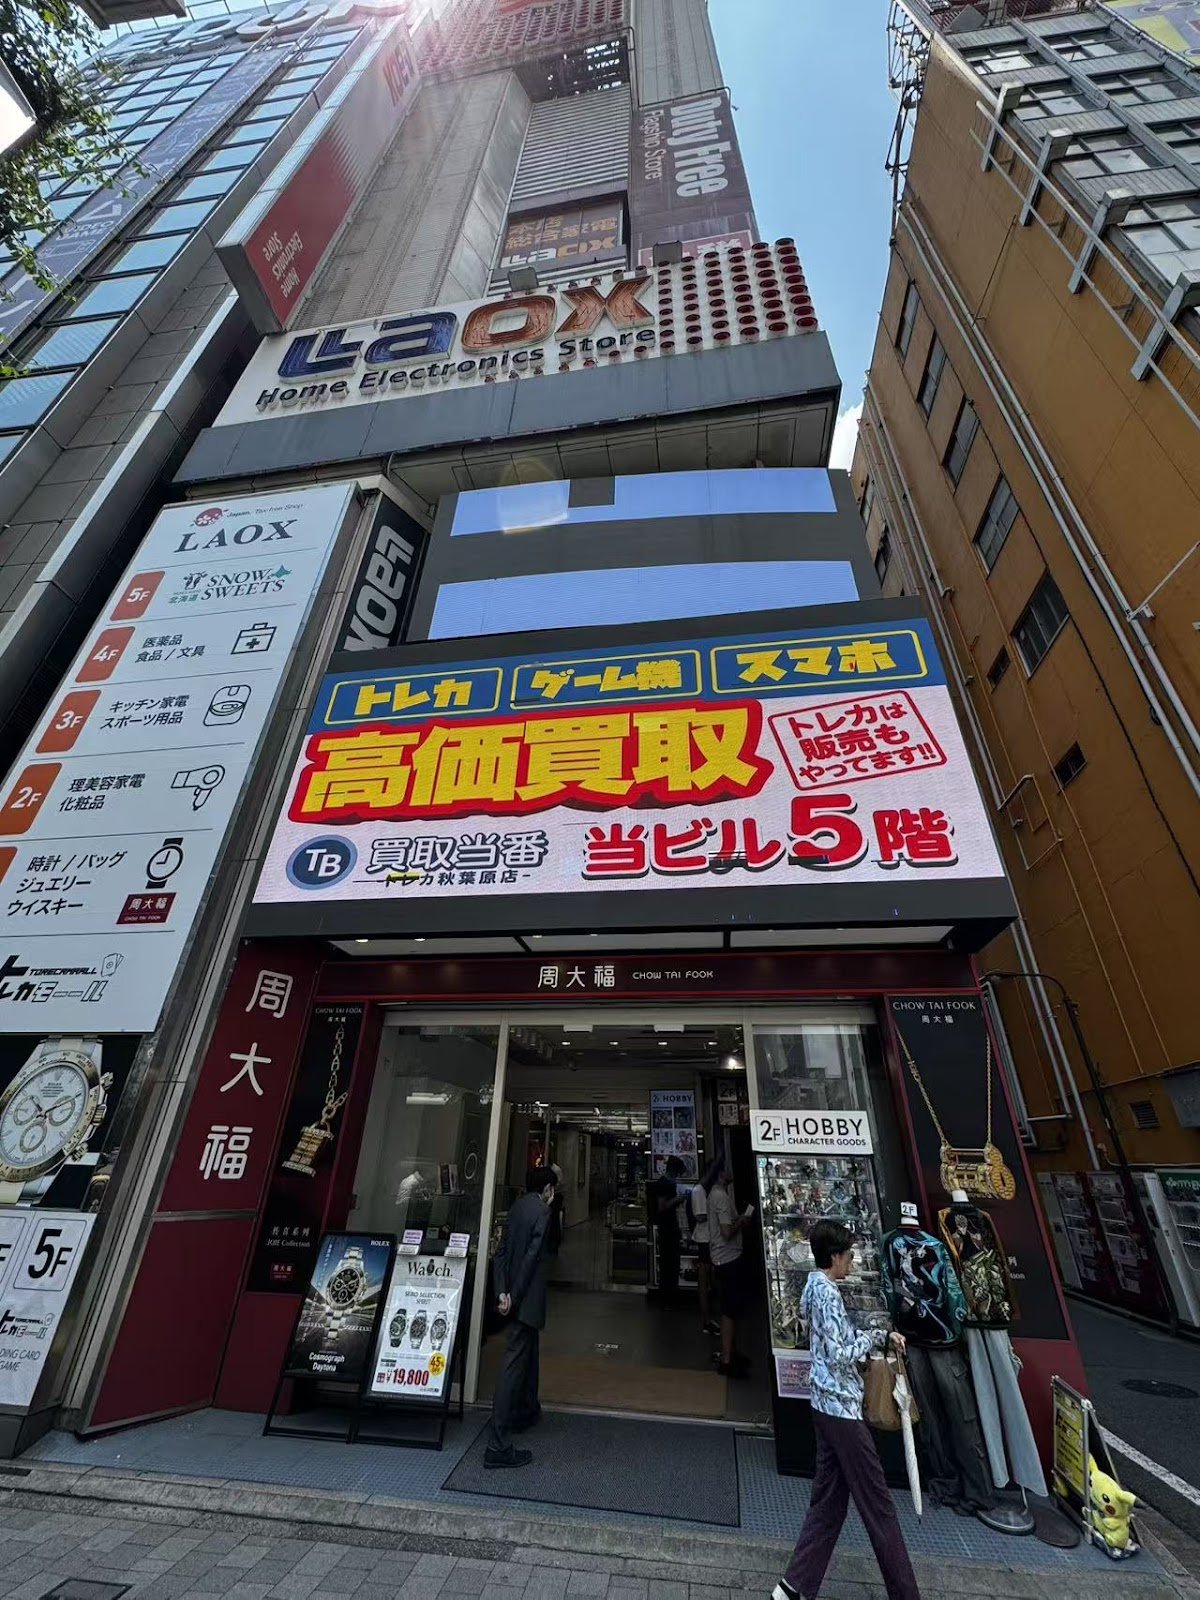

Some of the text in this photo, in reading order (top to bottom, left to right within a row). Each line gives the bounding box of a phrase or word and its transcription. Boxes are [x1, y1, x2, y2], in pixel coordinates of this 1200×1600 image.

[667, 97, 723, 146] Duty
[640, 109, 667, 180] Flagship Store
[674, 141, 732, 197] Free
[262, 231, 283, 262] Store
[271, 231, 304, 281] Electronics
[280, 267, 300, 299] Home
[254, 327, 656, 408] Home Electronics Store
[173, 519, 298, 553] LAOX
[126, 587, 151, 603] 5F
[201, 579, 286, 601] SWEETS
[142, 634, 184, 649] 医薬品
[93, 645, 119, 662] 4F
[135, 649, 162, 663] 食品
[176, 645, 206, 659] 文具
[736, 639, 897, 684] スマホ
[530, 658, 683, 700] ゲーム機
[109, 695, 190, 713] キッチン家電
[353, 678, 473, 716] トレカ
[55, 710, 84, 730] 3F
[100, 711, 184, 730] スポーツ用品
[787, 702, 908, 739] トレカは
[799, 723, 910, 763] 販売も
[298, 705, 760, 815] 高価買取
[68, 773, 146, 793] 理美容家電
[10, 786, 43, 809] 2F
[59, 794, 106, 812] 化粧品
[26, 855, 61, 873] 時計
[77, 851, 128, 869] バッグ
[304, 848, 342, 878] TB
[366, 830, 549, 875] 買取当番
[16, 875, 92, 894] ジュエリー
[7, 899, 84, 917] ウイスキー
[128, 897, 168, 910] 周大福
[537, 965, 616, 989] 周大福
[632, 970, 714, 980] CHOW TAI FOOK
[892, 1001, 977, 1010] CHOW TAI FOOK
[921, 1014, 954, 1023] 周大福
[199, 969, 294, 1181] 周大福
[663, 1094, 693, 1103] HOBBY
[760, 1119, 781, 1141] 2F
[785, 1117, 863, 1136] HOBBY
[788, 1137, 867, 1146] CHARACTER GOODS
[902, 1203, 915, 1215] 2F
[27, 1228, 73, 1279] 5F
[370, 1239, 391, 1247] ROLEX
[0, 1348, 41, 1361] DING CARD
[308, 1351, 345, 1364] Cosmograph
[312, 1361, 337, 1372] Daytona
